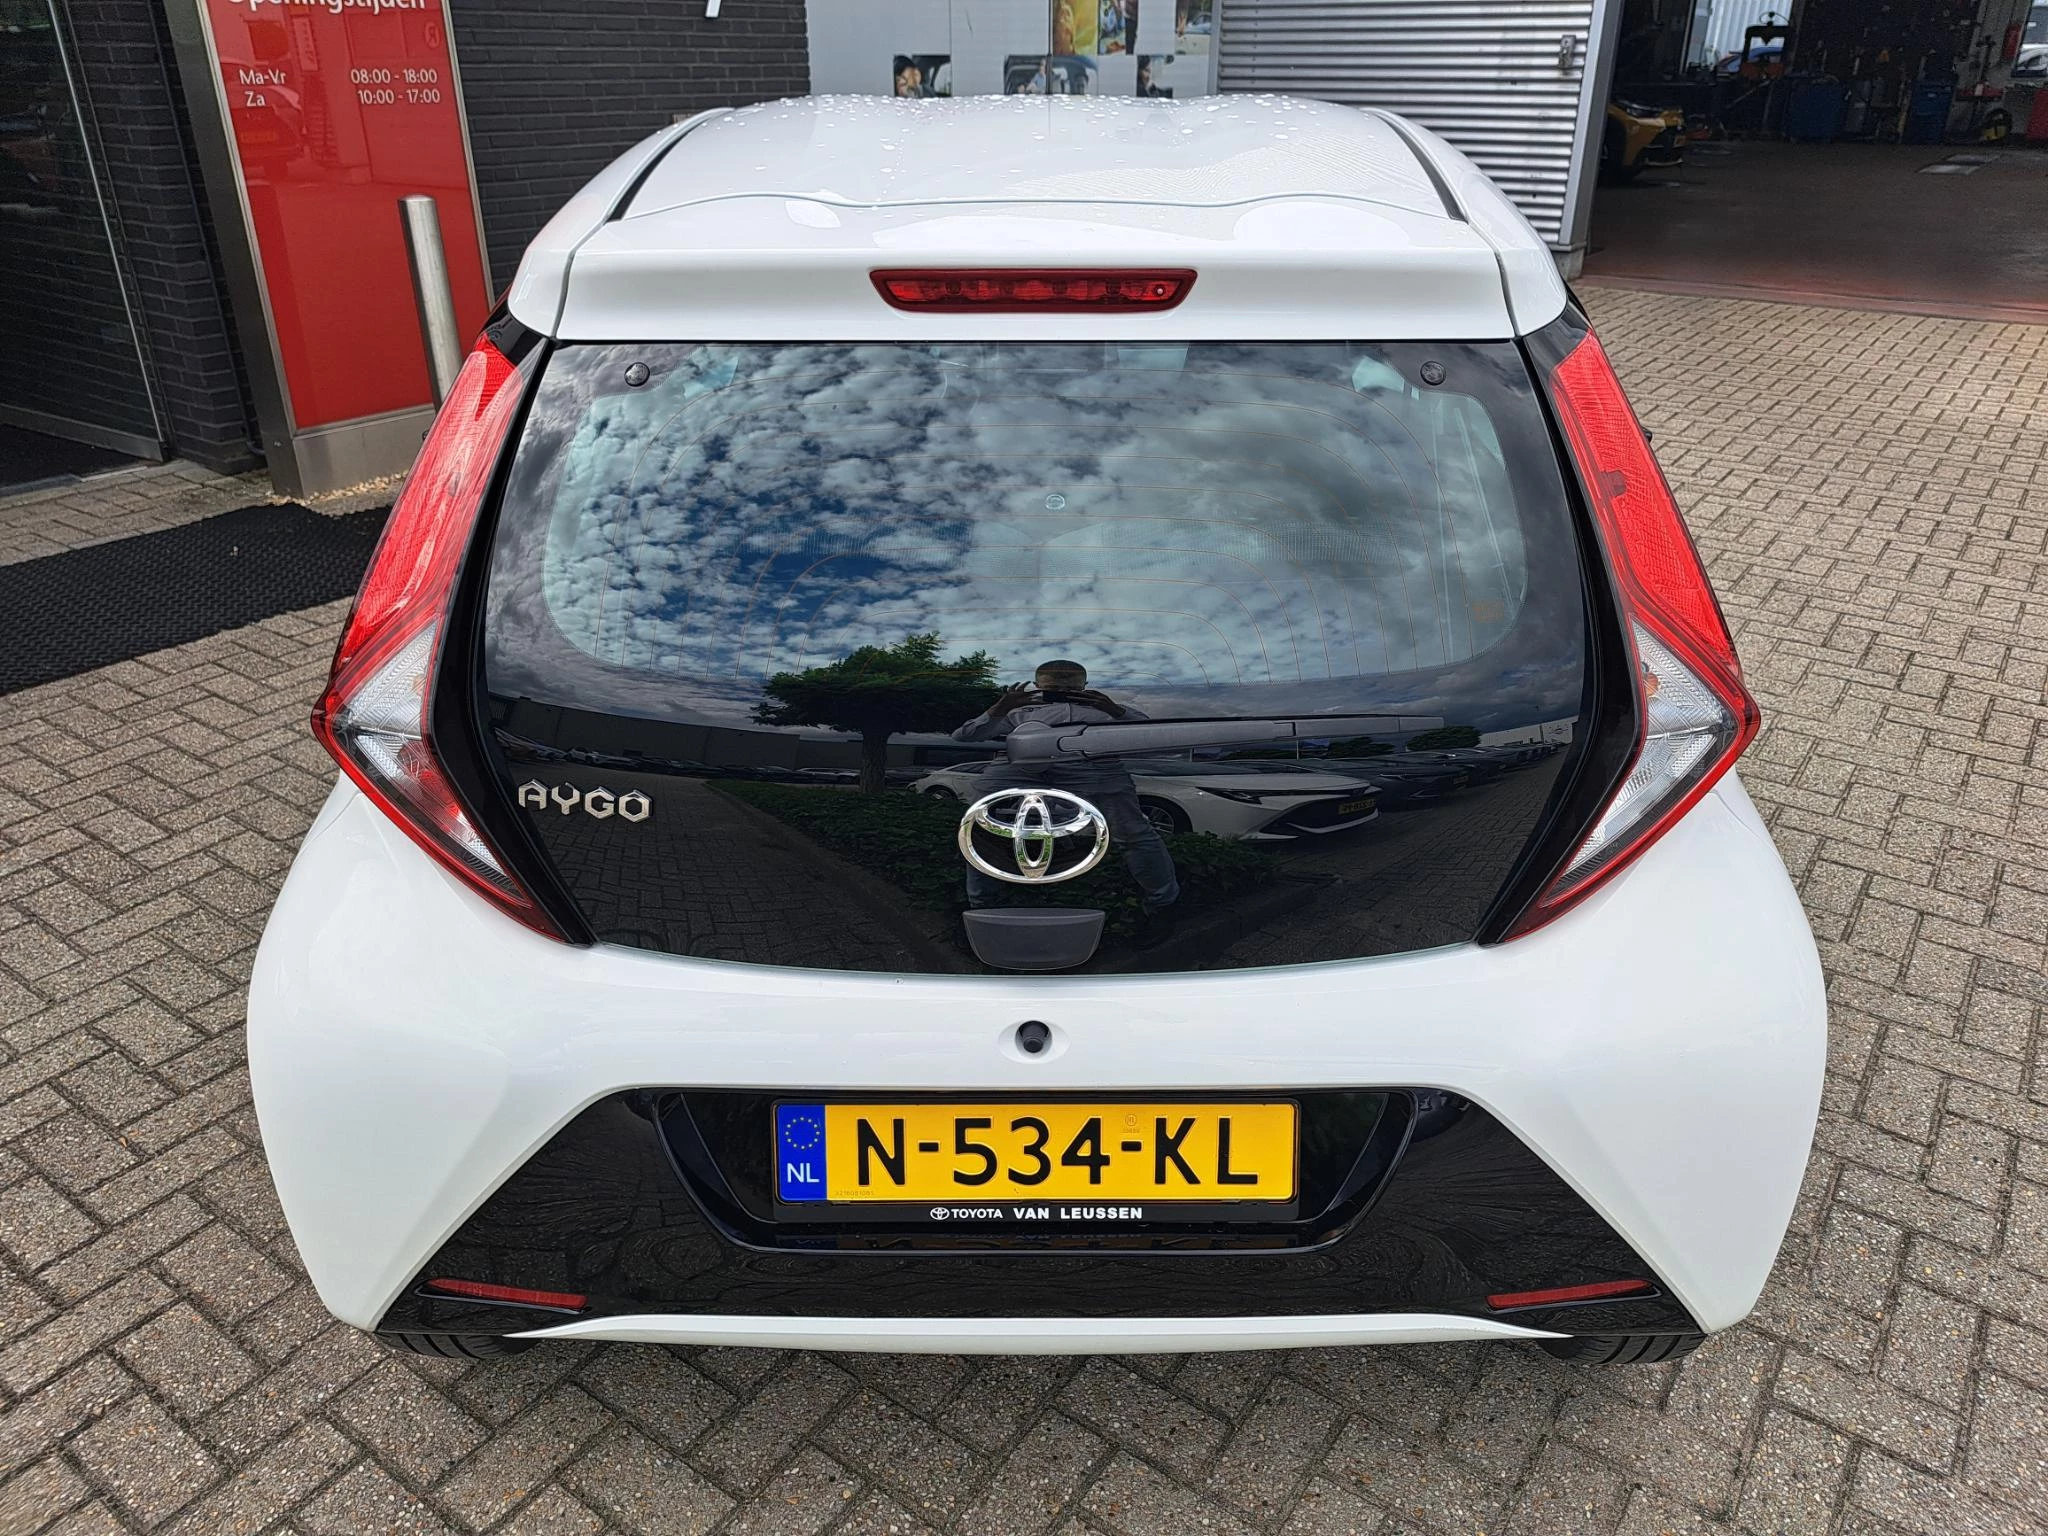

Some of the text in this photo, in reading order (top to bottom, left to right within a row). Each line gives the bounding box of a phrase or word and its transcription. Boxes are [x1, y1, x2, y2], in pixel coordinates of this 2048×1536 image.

[239, 69, 286, 85] Ma-Vr
[350, 68, 391, 84] 08:00
[402, 68, 438, 84] 18:00
[244, 91, 266, 107] Za
[357, 89, 395, 105] 10:00
[406, 89, 440, 104] 17:00
[518, 779, 652, 823] AYGO
[857, 1116, 1259, 1186] N-534-KL
[786, 1163, 820, 1184] NL
[950, 1207, 1142, 1220] TOYOTA VAN LEUSSEN
